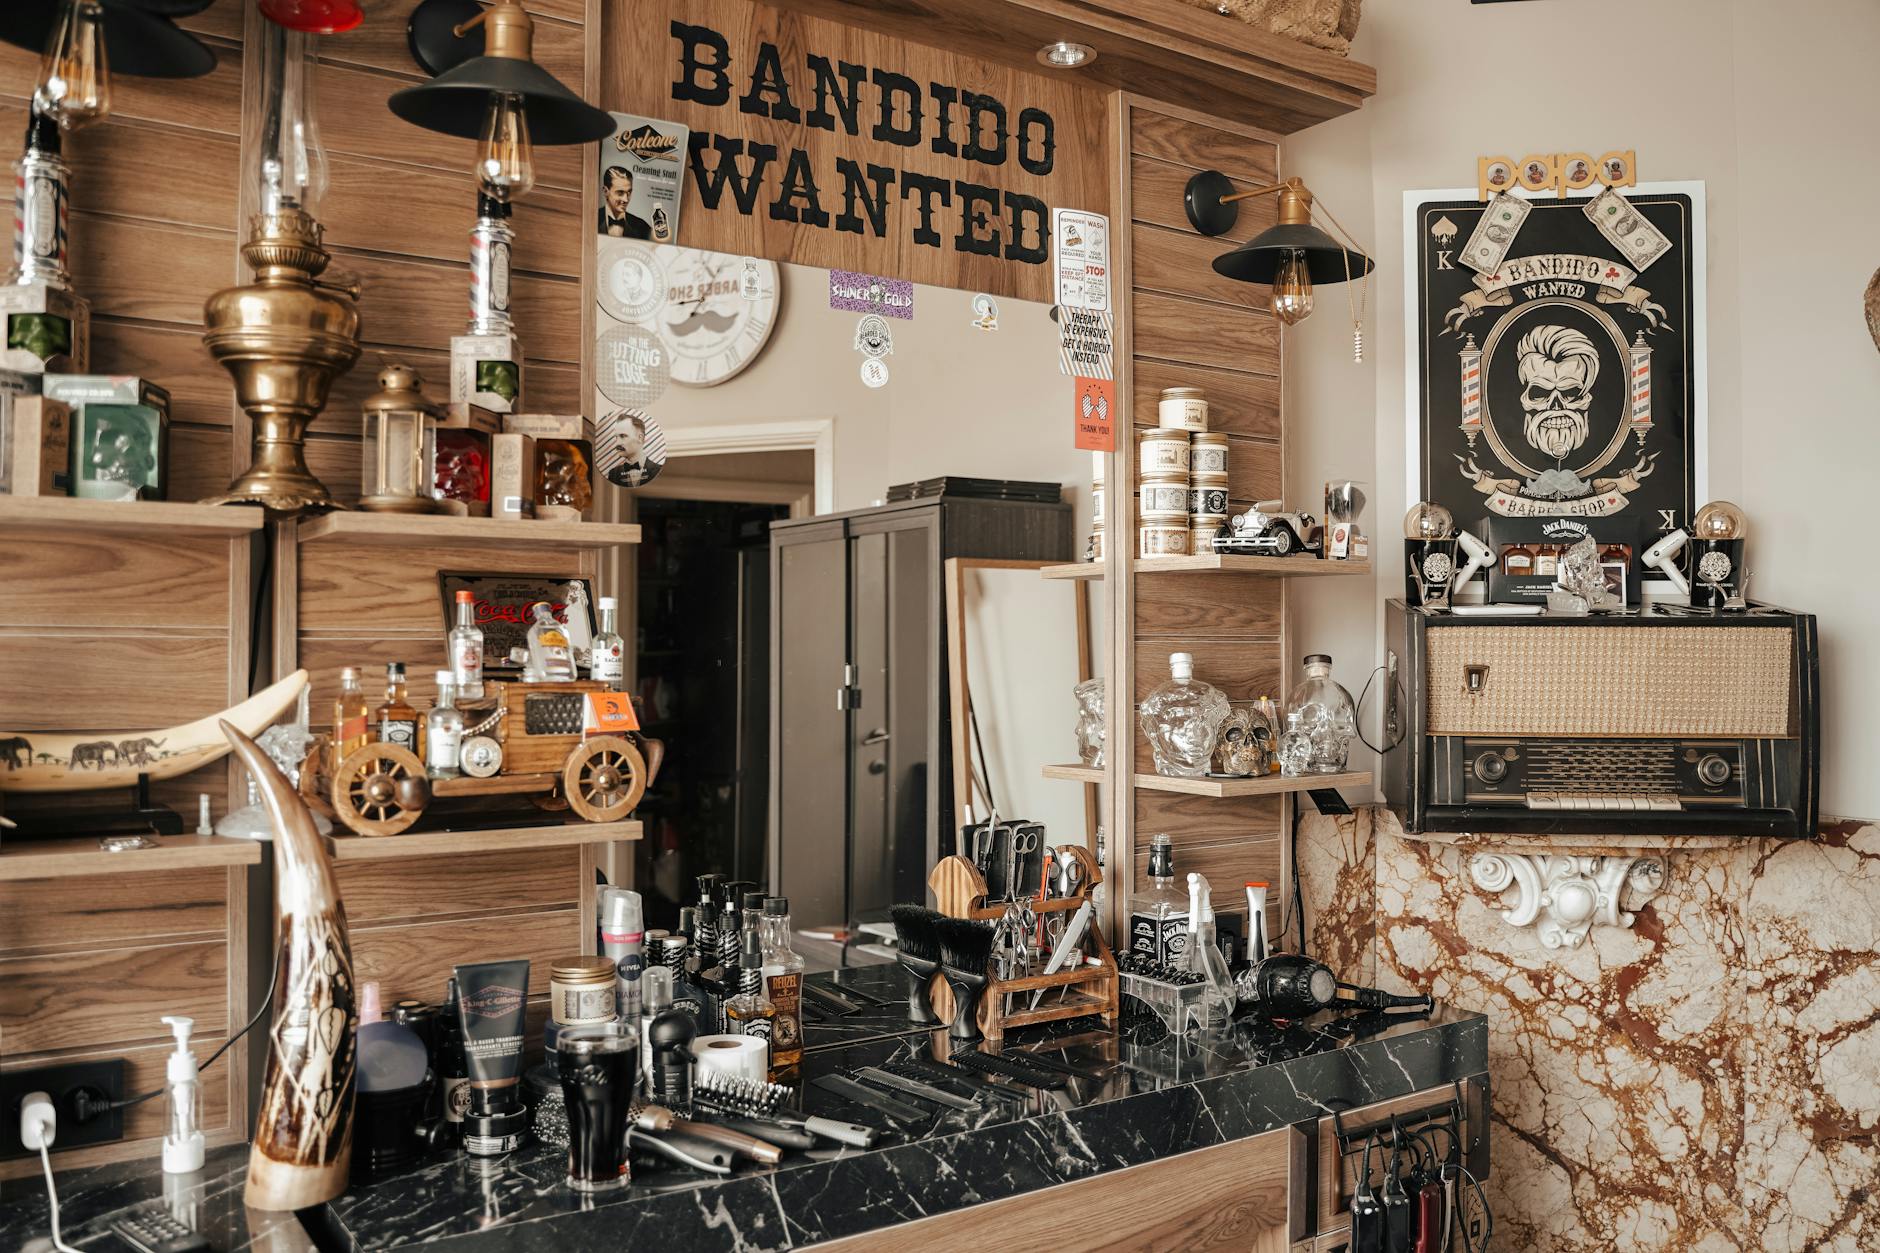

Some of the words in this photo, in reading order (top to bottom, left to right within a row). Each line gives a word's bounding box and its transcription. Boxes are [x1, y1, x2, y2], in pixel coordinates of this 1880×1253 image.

[670, 20, 1057, 176] BANDIDO
[612, 128, 680, 152] Corleone
[1477, 151, 1636, 203] papa
[687, 130, 1053, 265] WANTED
[1087, 220, 1104, 229] WASH
[1437, 251, 1455, 270] K
[1085, 265, 1105, 277] STOP
[1508, 258, 1601, 283] BANDIDO
[832, 284, 870, 301] SHINER
[884, 292, 913, 308] GOLD
[1522, 281, 1587, 300] WANTED
[1072, 312, 1100, 325] THERAPY
[1064, 323, 1071, 334] IS
[1072, 324, 1107, 339] EXPENSIVE
[1063, 337, 1075, 349] GET
[1075, 339, 1082, 350] A
[1082, 340, 1111, 355] HAIRCUT
[1072, 351, 1100, 365] INSTEAD
[614, 359, 651, 385] EDGE
[1080, 423, 1097, 434] THANK
[1542, 520, 1561, 536] JACK
[1560, 518, 1589, 536] DANIEL'S
[1162, 926, 1177, 942] JACK
[620, 963, 641, 972] NIVEA
[773, 974, 798, 990] REUZEL
